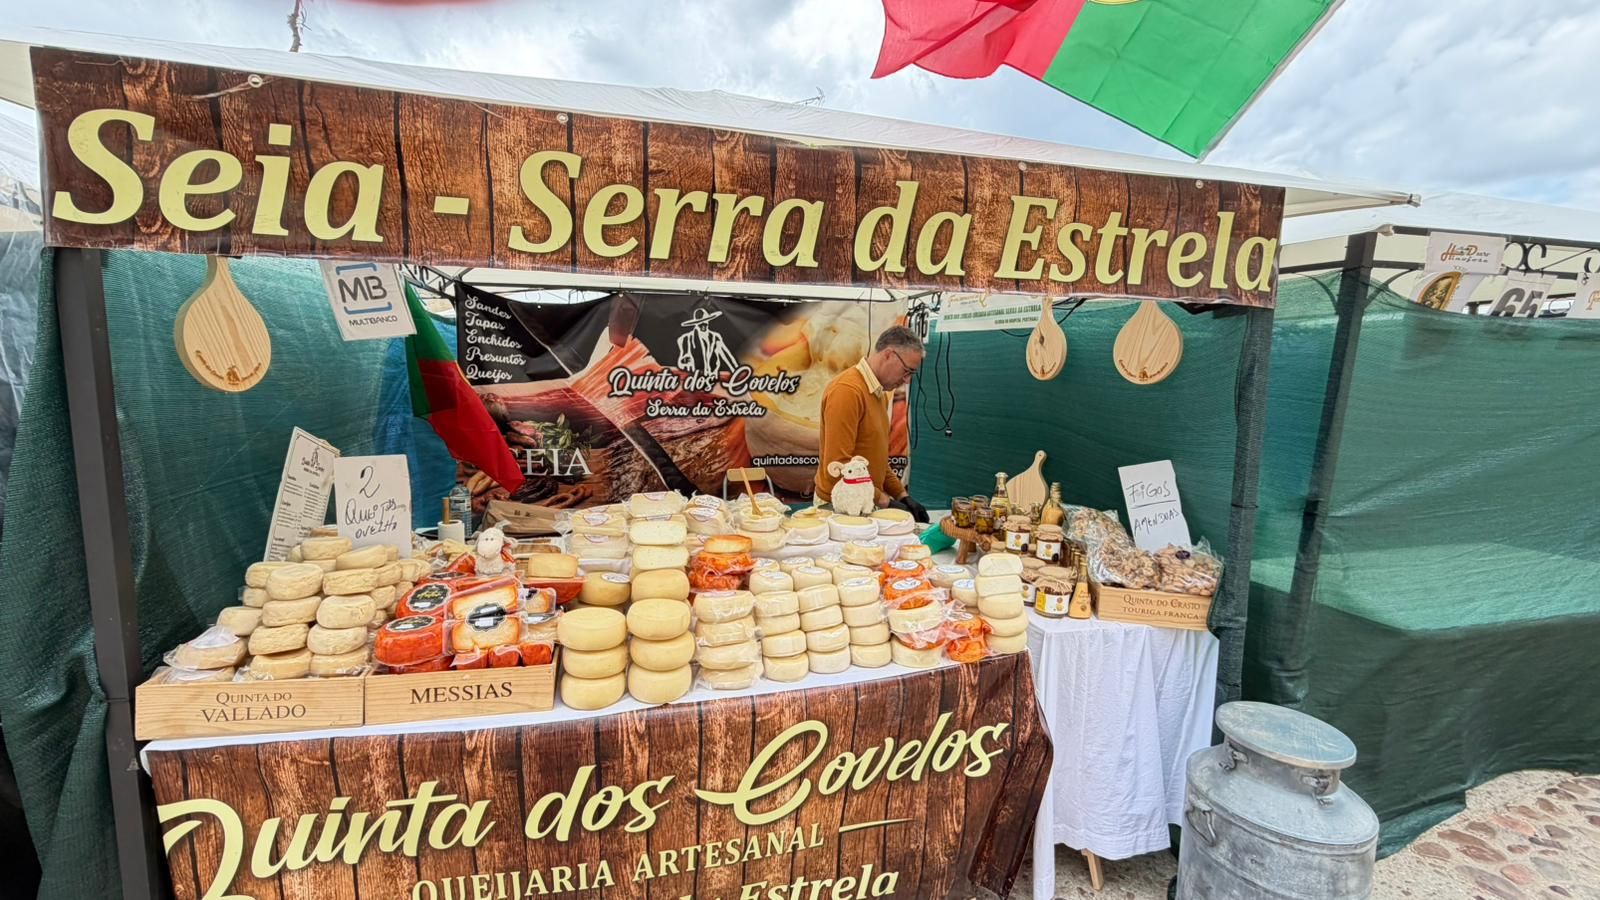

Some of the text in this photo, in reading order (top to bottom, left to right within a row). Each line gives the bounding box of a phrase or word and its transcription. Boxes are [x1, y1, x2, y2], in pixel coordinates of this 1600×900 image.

[53, 109, 1277, 292] Seia - Serra da Estrela
[338, 276, 387, 303] MB
[464, 294, 512, 320] Sandes
[349, 315, 398, 326] MULTIBANCO
[465, 311, 506, 331] Tapas
[465, 330, 523, 350] Enchidos
[465, 346, 528, 366] Presuntos
[465, 364, 513, 383] Queijos
[609, 366, 801, 397] Quinta dos Covelos
[647, 398, 766, 418] Serra da Estrela
[513, 447, 593, 478] EIA
[360, 466, 380, 498] 2
[1123, 594, 1200, 610] QUINTA DO CRASTO
[1123, 606, 1199, 619] TOURIGA FRANCA
[216, 692, 292, 707] QUINTA DO
[409, 681, 513, 705] MESSIAS
[201, 704, 306, 723] VALLADO
[525, 765, 676, 842] dos
[695, 712, 1009, 825] Covelos
[412, 823, 825, 900] QUEIJARIA ARTESANAL
